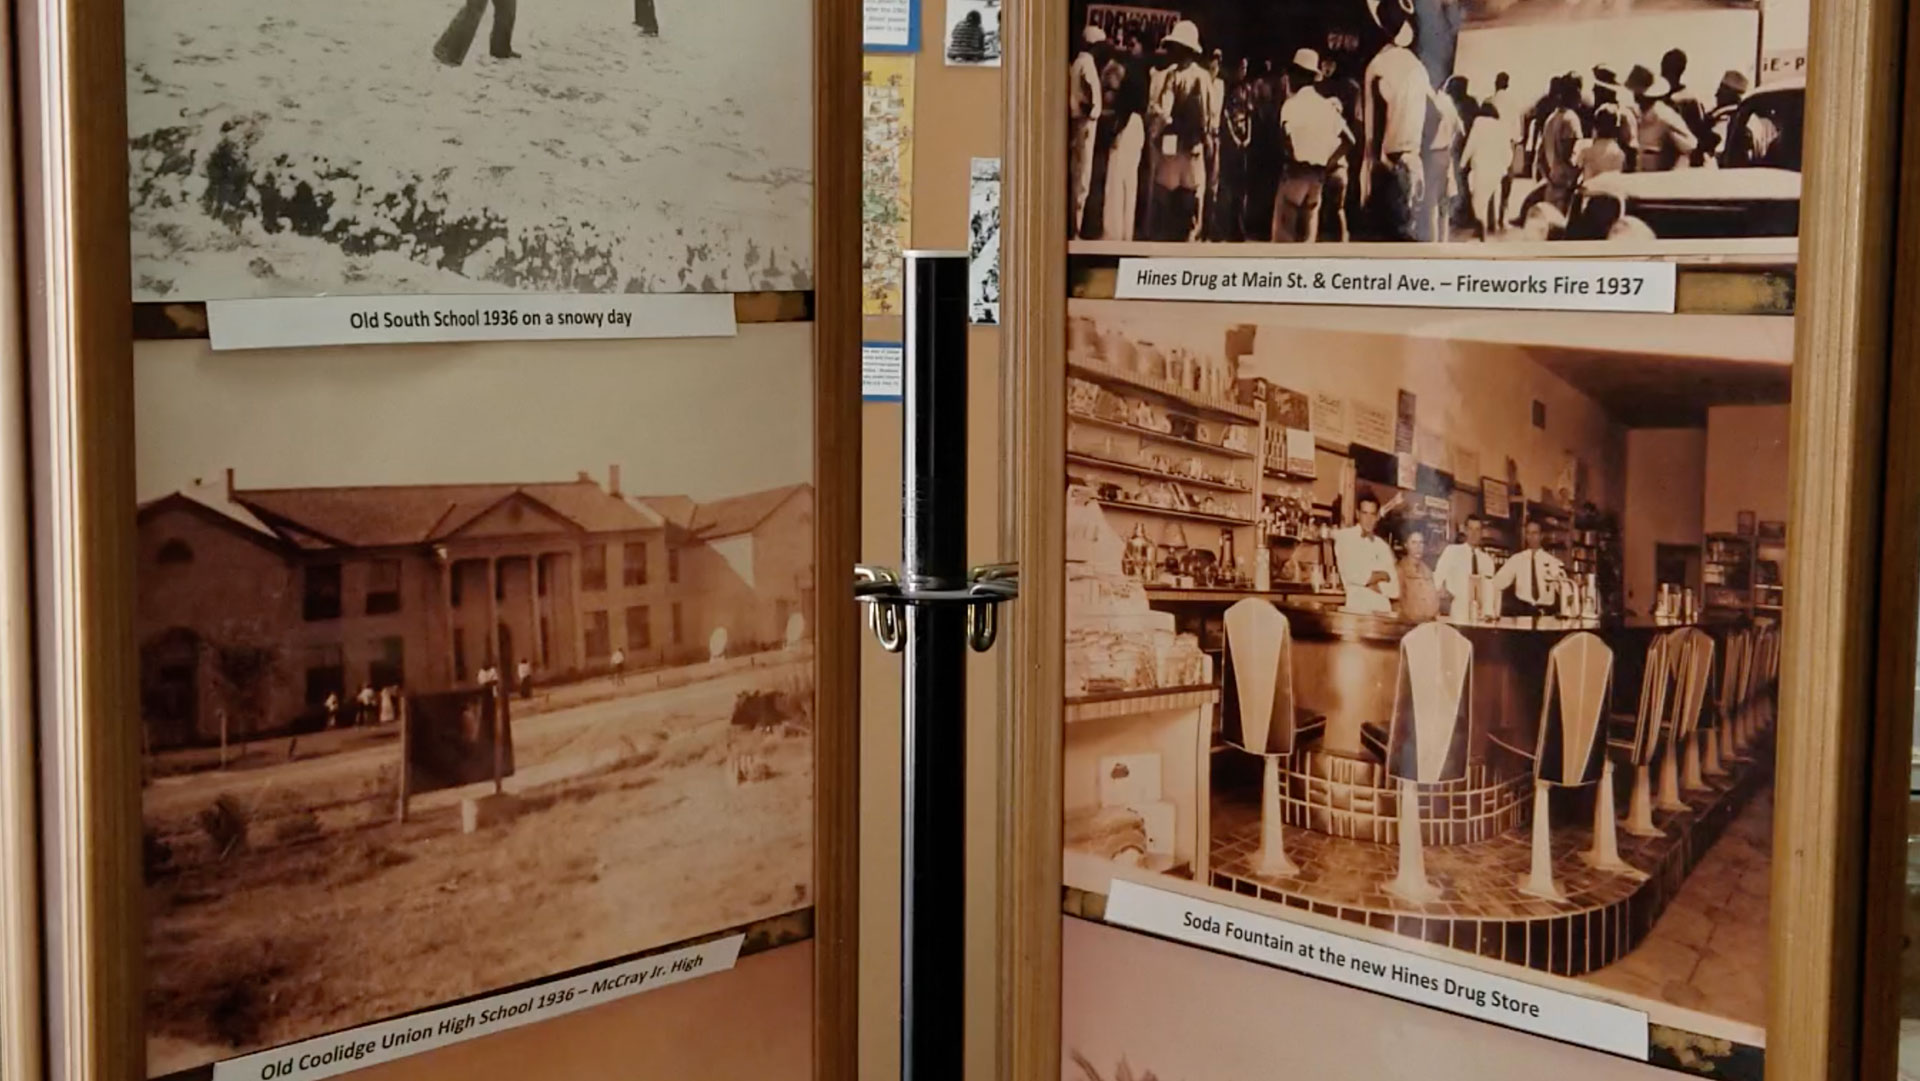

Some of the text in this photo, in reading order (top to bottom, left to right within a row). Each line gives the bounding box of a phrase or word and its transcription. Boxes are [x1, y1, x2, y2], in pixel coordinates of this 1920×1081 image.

[1090, 8, 1178, 47] FIREORKS
[1136, 269, 1177, 285] Hines
[1181, 270, 1218, 290] Drug
[1221, 272, 1237, 287] at
[1241, 271, 1282, 288] Main
[1286, 272, 1307, 288] St.
[1312, 271, 1325, 288] &
[1331, 272, 1391, 290] Central
[1396, 274, 1434, 291] Ave.
[1456, 274, 1547, 293] Fireworks
[1553, 275, 1589, 294] Fire
[1595, 276, 1643, 295] 1937
[349, 308, 632, 329] Old South School 1936 on a snowy day
[1183, 911, 1539, 1017] Soda Fountain at the new Hines Drug Store
[260, 1057, 293, 1080] Old
[298, 1040, 376, 1070] Coolidge
[381, 1026, 432, 1049] Union
[437, 1013, 475, 1035] High
[478, 997, 534, 1025] School
[536, 987, 575, 1009] 1936
[590, 970, 648, 994] McCray
[649, 965, 666, 979] Jr.
[670, 954, 703, 973] High
